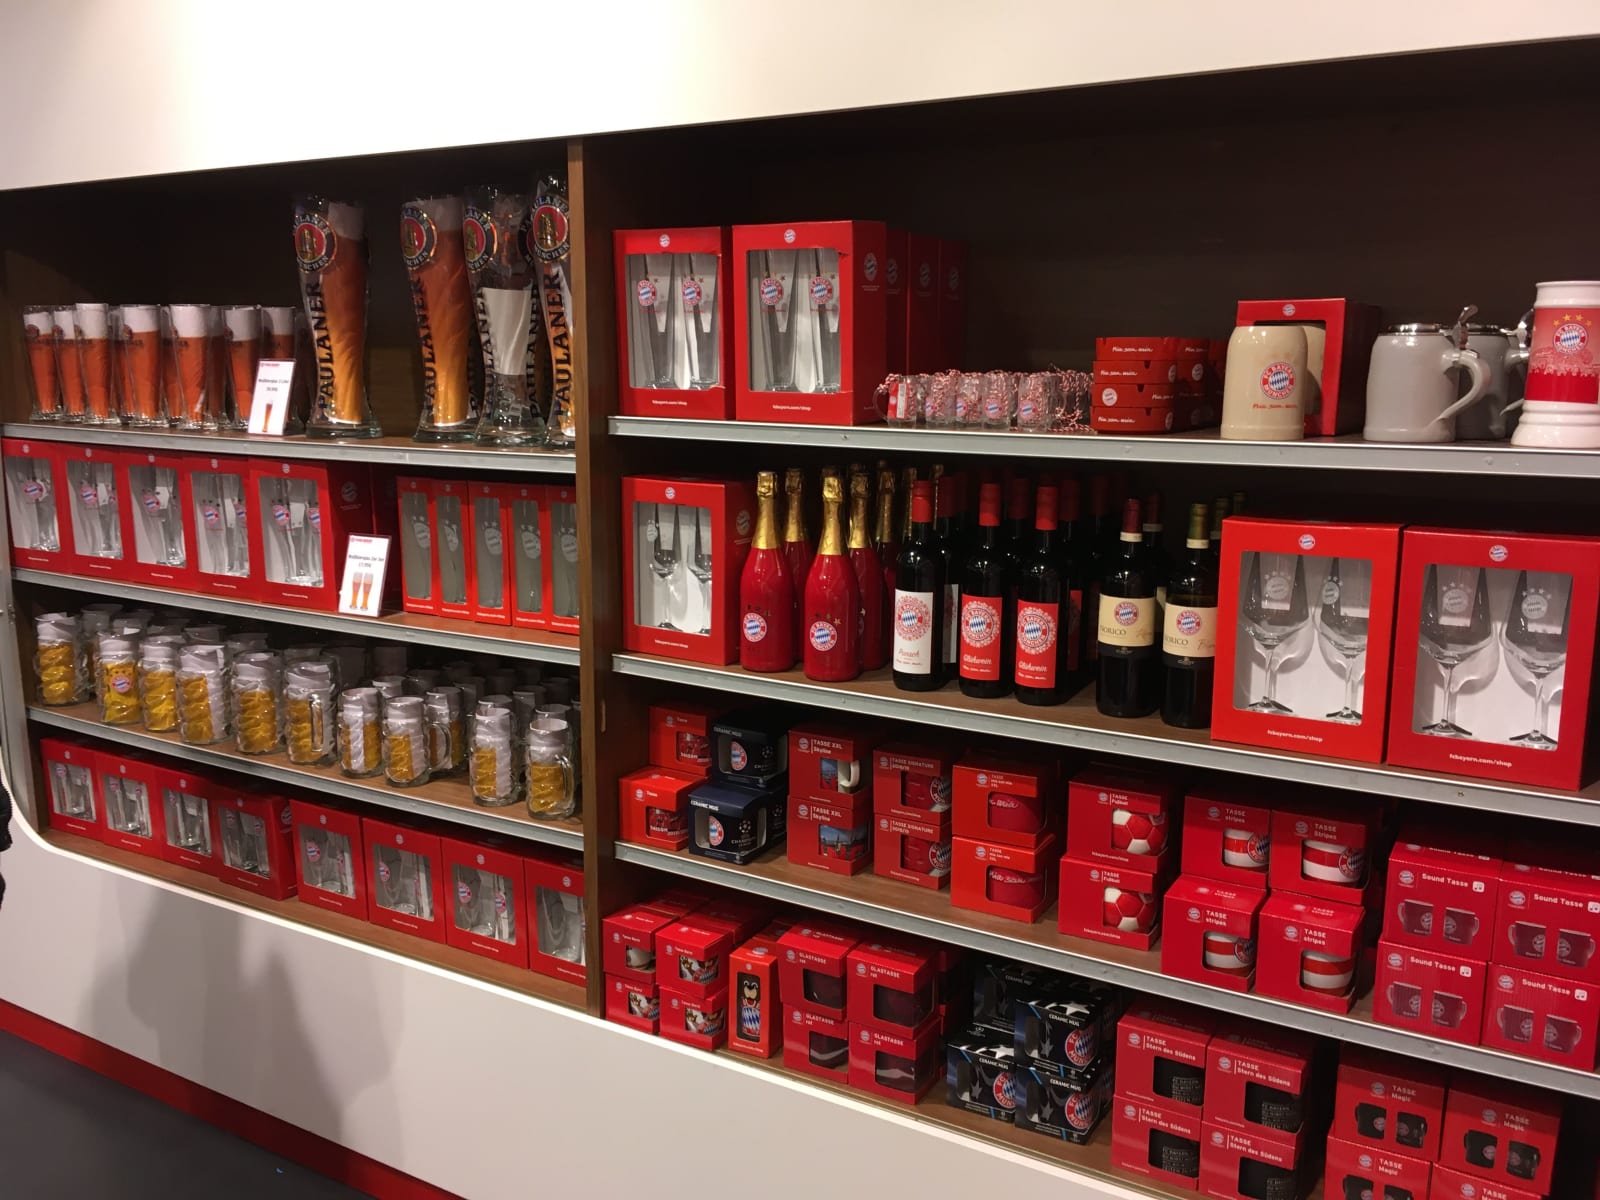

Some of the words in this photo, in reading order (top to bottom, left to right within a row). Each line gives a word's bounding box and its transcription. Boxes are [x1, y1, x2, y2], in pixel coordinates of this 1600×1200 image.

[310, 280, 334, 412] PAULANER
[415, 274, 437, 411] PAULANER
[544, 271, 571, 416] PAULANER
[1267, 729, 1323, 743] fcbayern.com/shop
[813, 739, 831, 748] TASSE
[813, 746, 832, 755] Skyline
[1449, 753, 1512, 768] fcbayern.com/shop
[1111, 793, 1128, 801] TASSE
[812, 806, 830, 815] TASSE
[1225, 808, 1247, 817] TASSE
[812, 813, 831, 822] Skyline
[1314, 823, 1337, 833] TASSE
[1103, 870, 1120, 878] TASSE
[1421, 873, 1445, 884] Sound
[1446, 877, 1469, 888] Tasse
[1533, 893, 1558, 904] Sound
[1560, 898, 1584, 908] Tasse
[1205, 910, 1228, 919] TASSE
[1205, 917, 1227, 927] stripes
[1303, 928, 1326, 938] TASSE
[1303, 935, 1326, 946] stripes
[799, 951, 827, 965] GLASTASSE
[1410, 956, 1433, 967] Sound
[1434, 961, 1456, 972] Tasse
[870, 965, 900, 978] GLASTASSE
[1522, 978, 1546, 990] Sound
[1547, 984, 1571, 995] Tasse
[806, 1012, 834, 1026] GLASTASSE
[1049, 1013, 1068, 1024] CERAMIC
[1068, 1018, 1080, 1028] MUG
[874, 1033, 904, 1046] GLASTASSE
[1069, 1033, 1079, 1044] FC
[1146, 1036, 1167, 1046] TASSE
[1145, 1043, 1162, 1052] Stern
[1163, 1047, 1174, 1055] des
[1174, 1050, 1196, 1061] Südens
[978, 1057, 998, 1067] CERAMIC
[998, 1061, 1009, 1070] MUG
[1237, 1060, 1260, 1071] TASSE
[996, 1076, 1006, 1087] FC
[1237, 1068, 1255, 1077] Stern
[1255, 1072, 1266, 1080] des
[1267, 1075, 1291, 1087] Südens
[1049, 1078, 1069, 1089] CERAMIC
[1070, 1084, 1081, 1092] MUG
[1392, 1085, 1417, 1096] TASSE
[1069, 1096, 1079, 1107] FC
[1391, 1092, 1411, 1103] Magic
[1141, 1108, 1162, 1119] TASSE
[1505, 1113, 1530, 1125] TASSE
[1141, 1115, 1158, 1124] Stern
[1158, 1119, 1169, 1128] des
[1169, 1123, 1191, 1135] Südens
[1503, 1120, 1525, 1132] Magic
[1230, 1135, 1252, 1146] TASSE
[1229, 1142, 1248, 1152] Stern
[1248, 1147, 1259, 1156] des
[1259, 1150, 1283, 1162] Südens
[1379, 1158, 1403, 1170] TASSE
[1378, 1165, 1399, 1177] Magic
[1483, 1188, 1507, 1200] TASSE
